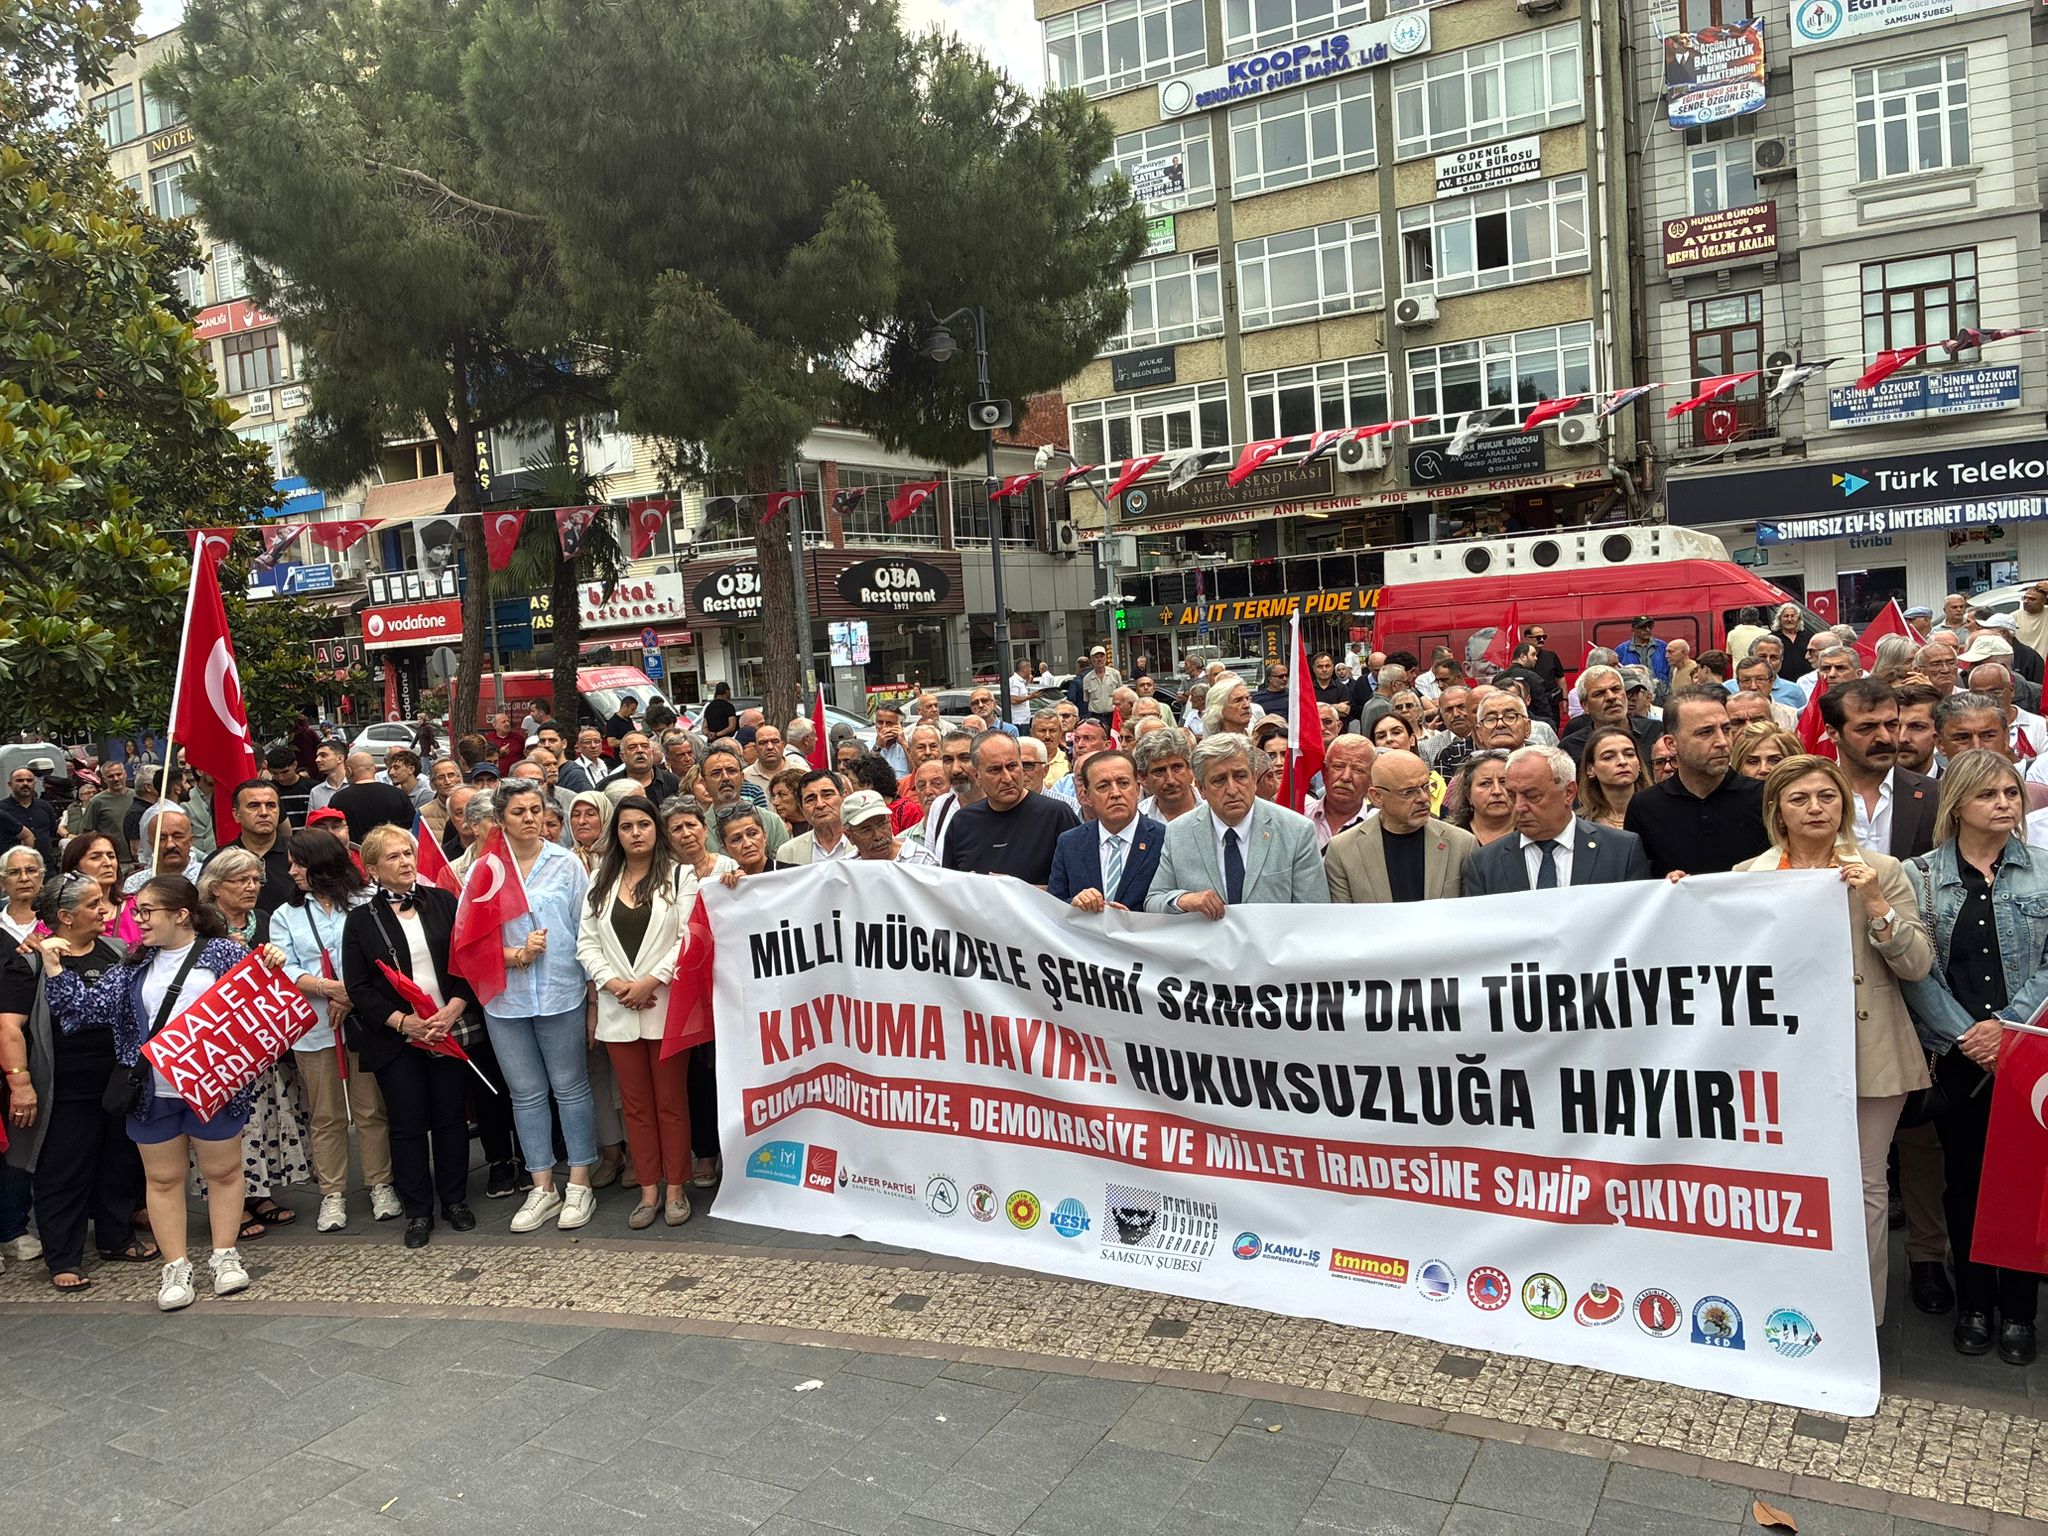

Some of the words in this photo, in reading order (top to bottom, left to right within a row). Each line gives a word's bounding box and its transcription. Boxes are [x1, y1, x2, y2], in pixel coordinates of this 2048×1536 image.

[1884, 13, 1921, 26] SAMSUN
[1922, 6, 1954, 21] ŞUBESİ
[1737, 35, 1748, 46] VE
[1694, 43, 1755, 68] BAĞIMSIZLIK
[1707, 62, 1728, 73] BENİM
[1195, 78, 1263, 108] SENDİKASI
[1266, 69, 1301, 91] ŞUBE
[1682, 91, 1705, 104] EĞİTİM
[1706, 88, 1724, 99] GÜCÜ
[1740, 82, 1750, 91] İLE
[1678, 101, 1705, 115] SENDE
[1707, 89, 1754, 107] ÖZGÜRLEŞ!
[1443, 161, 1482, 177] HUKUK
[1486, 149, 1533, 168] BÜROSU
[1469, 144, 1508, 161] DENGE
[1134, 168, 1165, 184] SATILIK
[1438, 179, 1453, 190] AV.
[1456, 173, 1482, 186] ESAD
[1484, 161, 1538, 182] ŞİRİNOĞLU
[1691, 213, 1725, 226] HUKUK
[1726, 205, 1768, 220] BÜROSU
[1702, 218, 1749, 231] ARABULUCU
[1682, 224, 1767, 247] AVUKAT
[1702, 241, 1736, 259] ÖZLEM
[1738, 234, 1776, 252] AKALIN
[1138, 357, 1164, 367] AVUKAT
[1132, 369, 1152, 378] BELGİN
[1943, 374, 1974, 387] SİNEM
[1977, 369, 2017, 384] ÖZKURT
[1846, 386, 1876, 399] SİNEM
[1880, 380, 1921, 394] ÖZKURT
[1929, 386, 1964, 395] SERBEST
[1969, 380, 2017, 391] MUHASEBECİ
[1948, 389, 1966, 399] MALİ
[1970, 387, 2001, 398] MÜŞAVİR
[1833, 398, 1867, 408] SERBEST
[1873, 390, 1921, 402] MUHASEBECİ
[1850, 402, 1868, 411] MALİ
[1872, 399, 1904, 409] MÜŞAVİR
[1477, 440, 1503, 451] HUKUK
[1507, 435, 1539, 447] BÜROSU
[1450, 453, 1478, 462] AVUKAT
[1485, 446, 1531, 457] ARABULUCU
[1464, 460, 1485, 468] Recep
[1487, 455, 1517, 465] ARSLAN
[1151, 485, 1188, 501] TÜRK
[1244, 466, 1323, 487] SENDİKASI
[1875, 466, 1938, 492] Türk
[1948, 458, 2048, 485] Teleko
[1150, 520, 1185, 532] KEBAP
[1201, 511, 1256, 526] KAHVALTI
[1272, 499, 1304, 517] ANIT
[1311, 494, 1361, 514] TERME
[1427, 485, 1469, 499] KEBAP
[1488, 474, 1553, 492] KAHVALTI
[1574, 468, 1602, 481] 7/24
[1192, 492, 1236, 506] SAMSUN
[1241, 486, 1281, 500] ŞUBESİ
[1777, 516, 1842, 541] SINIRSIZ
[1845, 511, 1886, 535] EV-İŞ
[1888, 505, 1962, 530] İNTERNET
[1966, 497, 2042, 525] BAŞVURU
[1850, 535, 1893, 549] tivibu
[874, 567, 920, 589] OBA
[588, 581, 656, 606] brtat
[861, 588, 936, 603] Restaurant
[583, 597, 674, 622] astanesi
[703, 596, 762, 613] Restaur
[738, 610, 757, 618] 1971
[1232, 596, 1301, 621] TERME
[1304, 590, 1353, 614] PİDE
[387, 613, 446, 632] vodafone
[402, 672, 411, 720] odafone
[749, 910, 842, 980] MİLLİ
[854, 914, 1027, 991] MÜCADELE
[1037, 953, 1143, 1014] ŞEHRİ
[170, 979, 296, 1092] ATATÜRK
[183, 1044, 256, 1106] VERDİ
[255, 995, 312, 1051] BİZE
[759, 993, 946, 1066] KAYYUMA
[962, 1009, 1117, 1084] HAYIR!!
[1126, 1042, 1535, 1131] HUKUKSUZLUĞA
[1560, 1067, 1784, 1145] HAYIR!!
[750, 1072, 960, 1132] CUMHURİYETİMİZE,
[969, 1097, 1147, 1160] DEMOKRASİYE
[1160, 1125, 1194, 1166] VE
[1205, 1131, 1304, 1181] MİLLET
[1317, 1143, 1480, 1201] İRADESİNE
[1494, 1164, 1590, 1216] SAHİP
[1605, 1178, 1818, 1238] ÇIKIYORUZ.
[780, 1148, 796, 1165] İYİ
[809, 1173, 832, 1187] CHP
[851, 1174, 881, 1188] ZAFER
[882, 1179, 916, 1195] PARTİSİ
[1009, 1193, 1028, 1206] EĞİTİM
[1163, 1195, 1218, 1220] ATATÜRKÇÜ
[1050, 1212, 1091, 1231] KESK
[1162, 1213, 1218, 1240] DÜŞÜNCE
[1157, 1234, 1216, 1257] DERNEĞİ
[1264, 1242, 1321, 1263] KAMU-İŞ
[1100, 1248, 1154, 1266] SAMSUN
[1156, 1256, 1203, 1272] ŞUBESİ
[1262, 1254, 1319, 1268] KONFEDERASYONU
[1334, 1251, 1406, 1277] tmmob
[1705, 1336, 1731, 1347] SED
